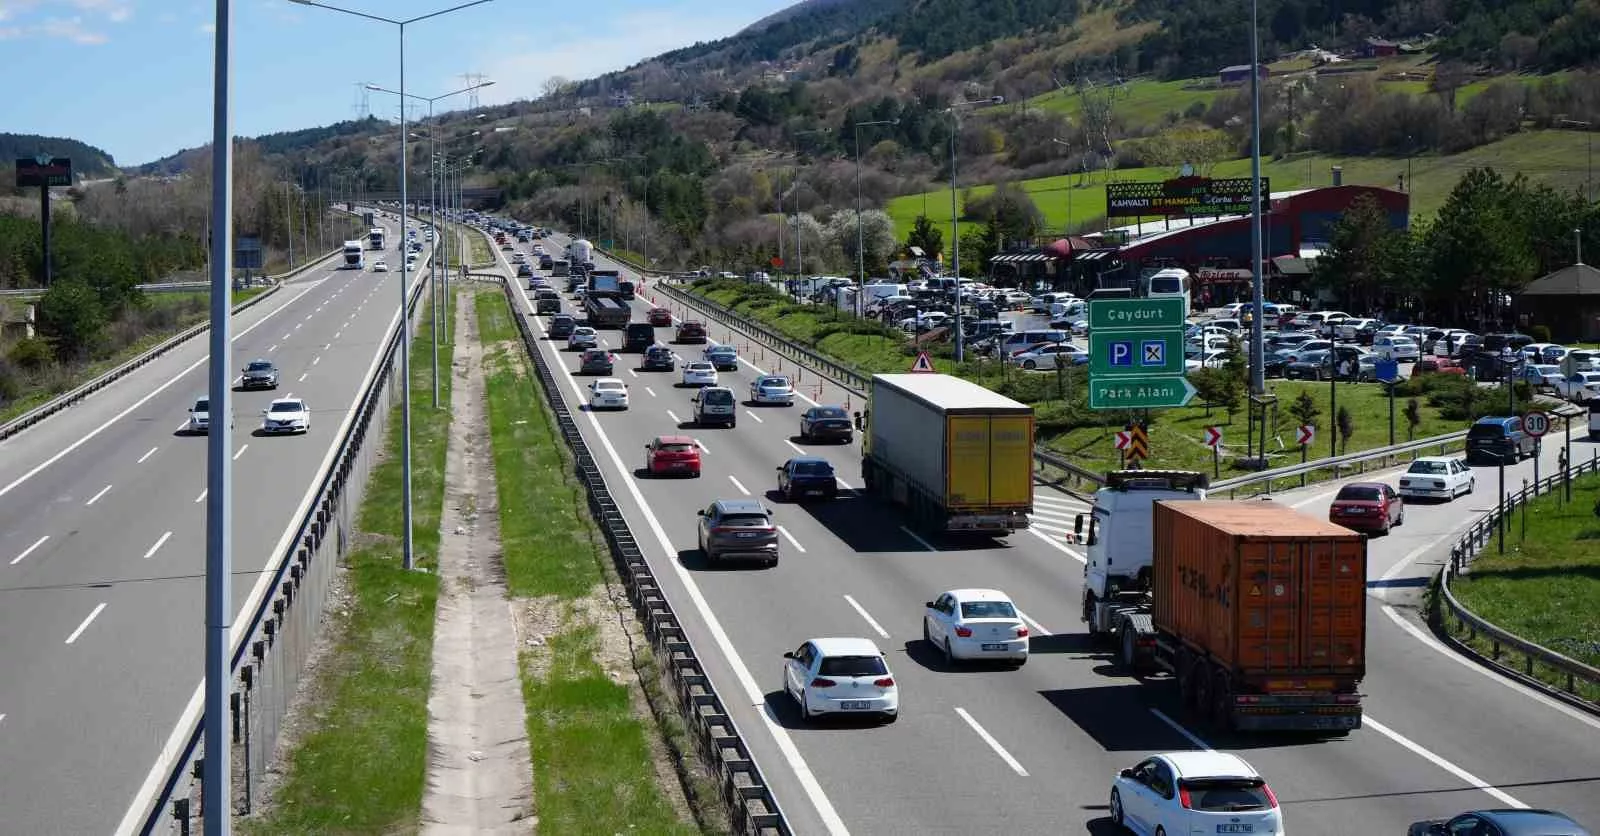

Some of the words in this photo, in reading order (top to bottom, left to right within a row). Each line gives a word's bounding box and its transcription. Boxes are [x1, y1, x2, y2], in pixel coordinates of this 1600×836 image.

[1111, 198, 1149, 208] KAHVALTI
[1114, 343, 1128, 364] P
[1099, 388, 1131, 399] Park
[1527, 416, 1544, 430] 30
